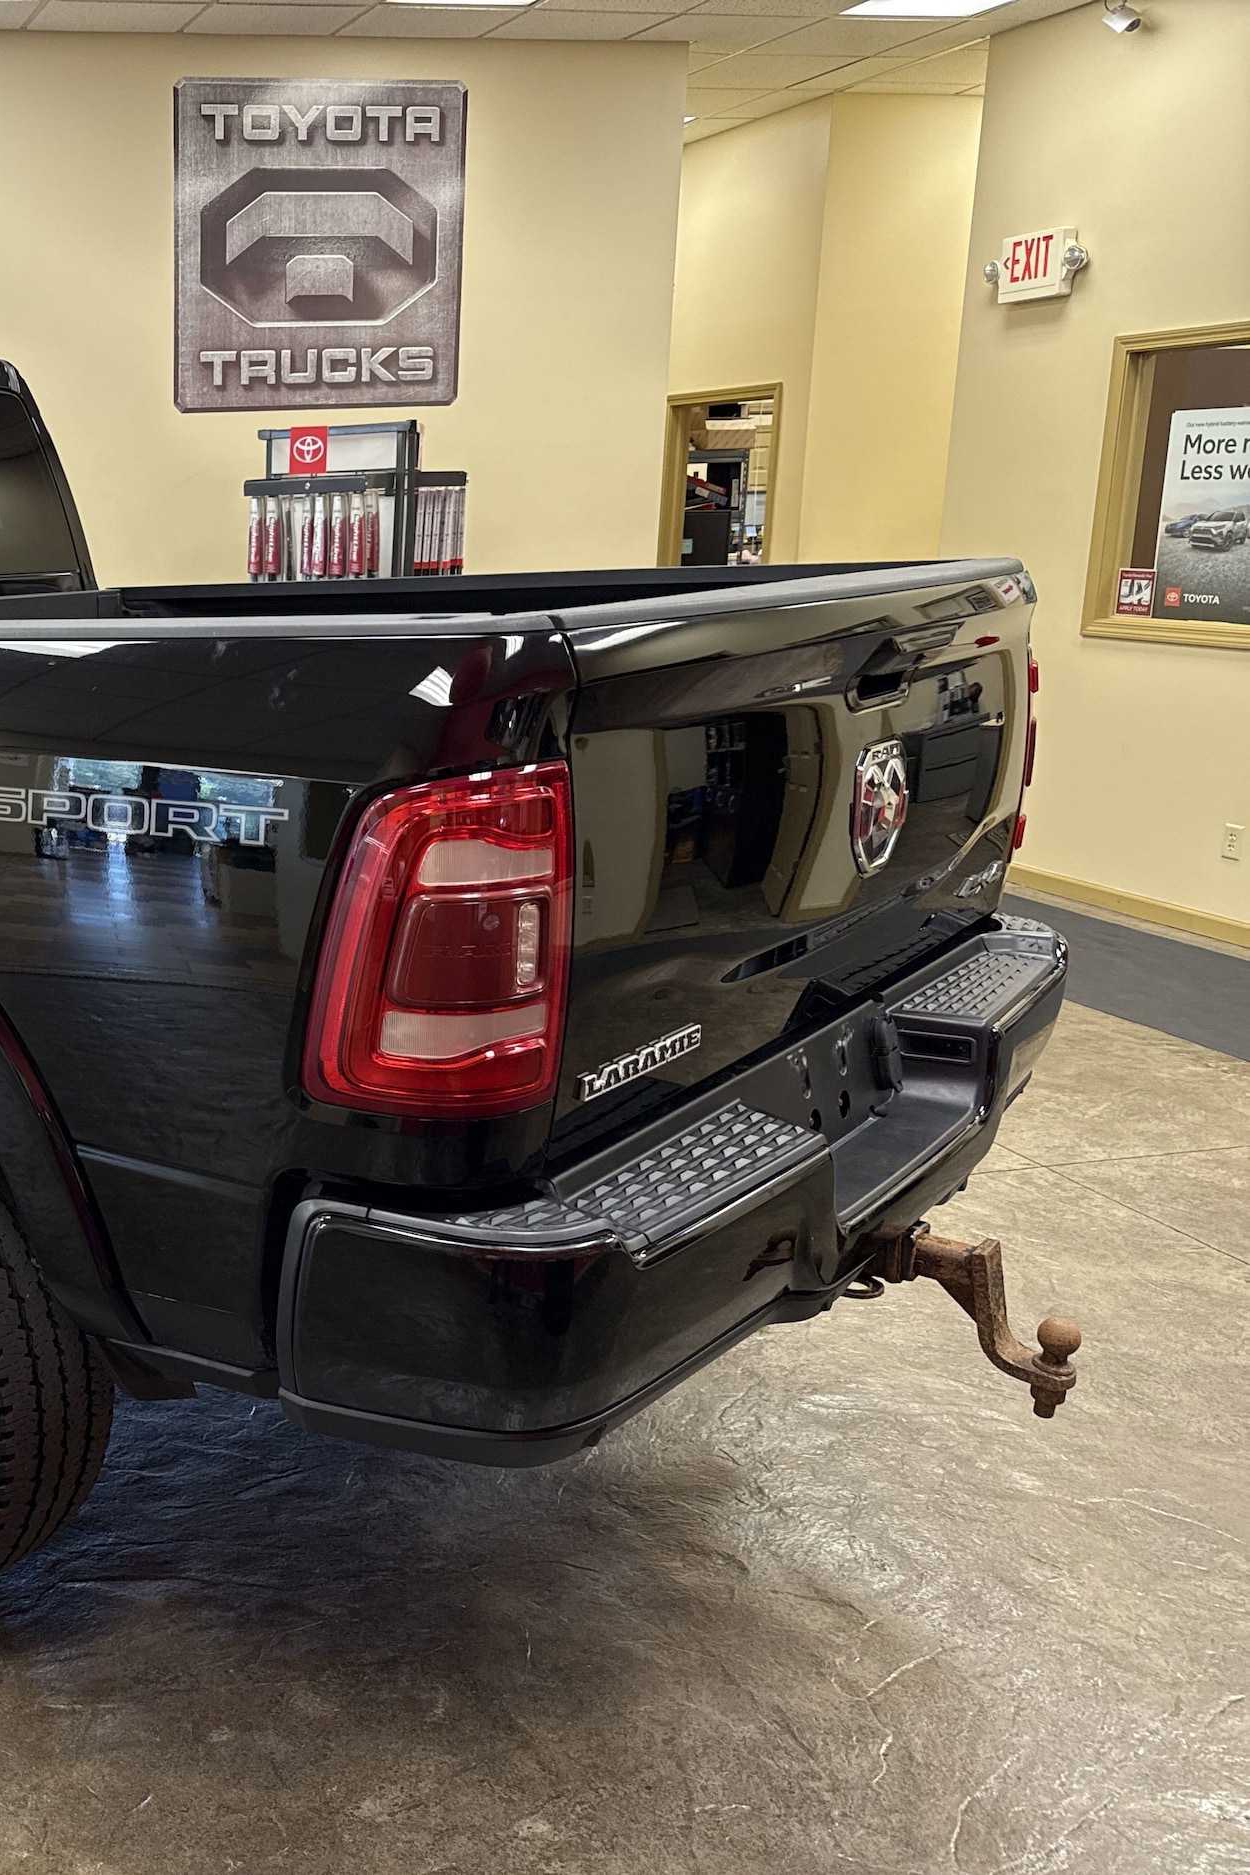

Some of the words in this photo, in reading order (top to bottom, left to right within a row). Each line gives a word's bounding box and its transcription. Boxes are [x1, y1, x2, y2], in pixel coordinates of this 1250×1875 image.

[201, 103, 441, 142] TOYOTA
[1010, 234, 1054, 283] EXIT
[200, 347, 434, 386] TRUCKS
[1183, 434, 1238, 455] More
[1180, 460, 1224, 480] Less
[1183, 593, 1220, 605] TOYOTA
[573, 1023, 702, 1102] LARAMIE
